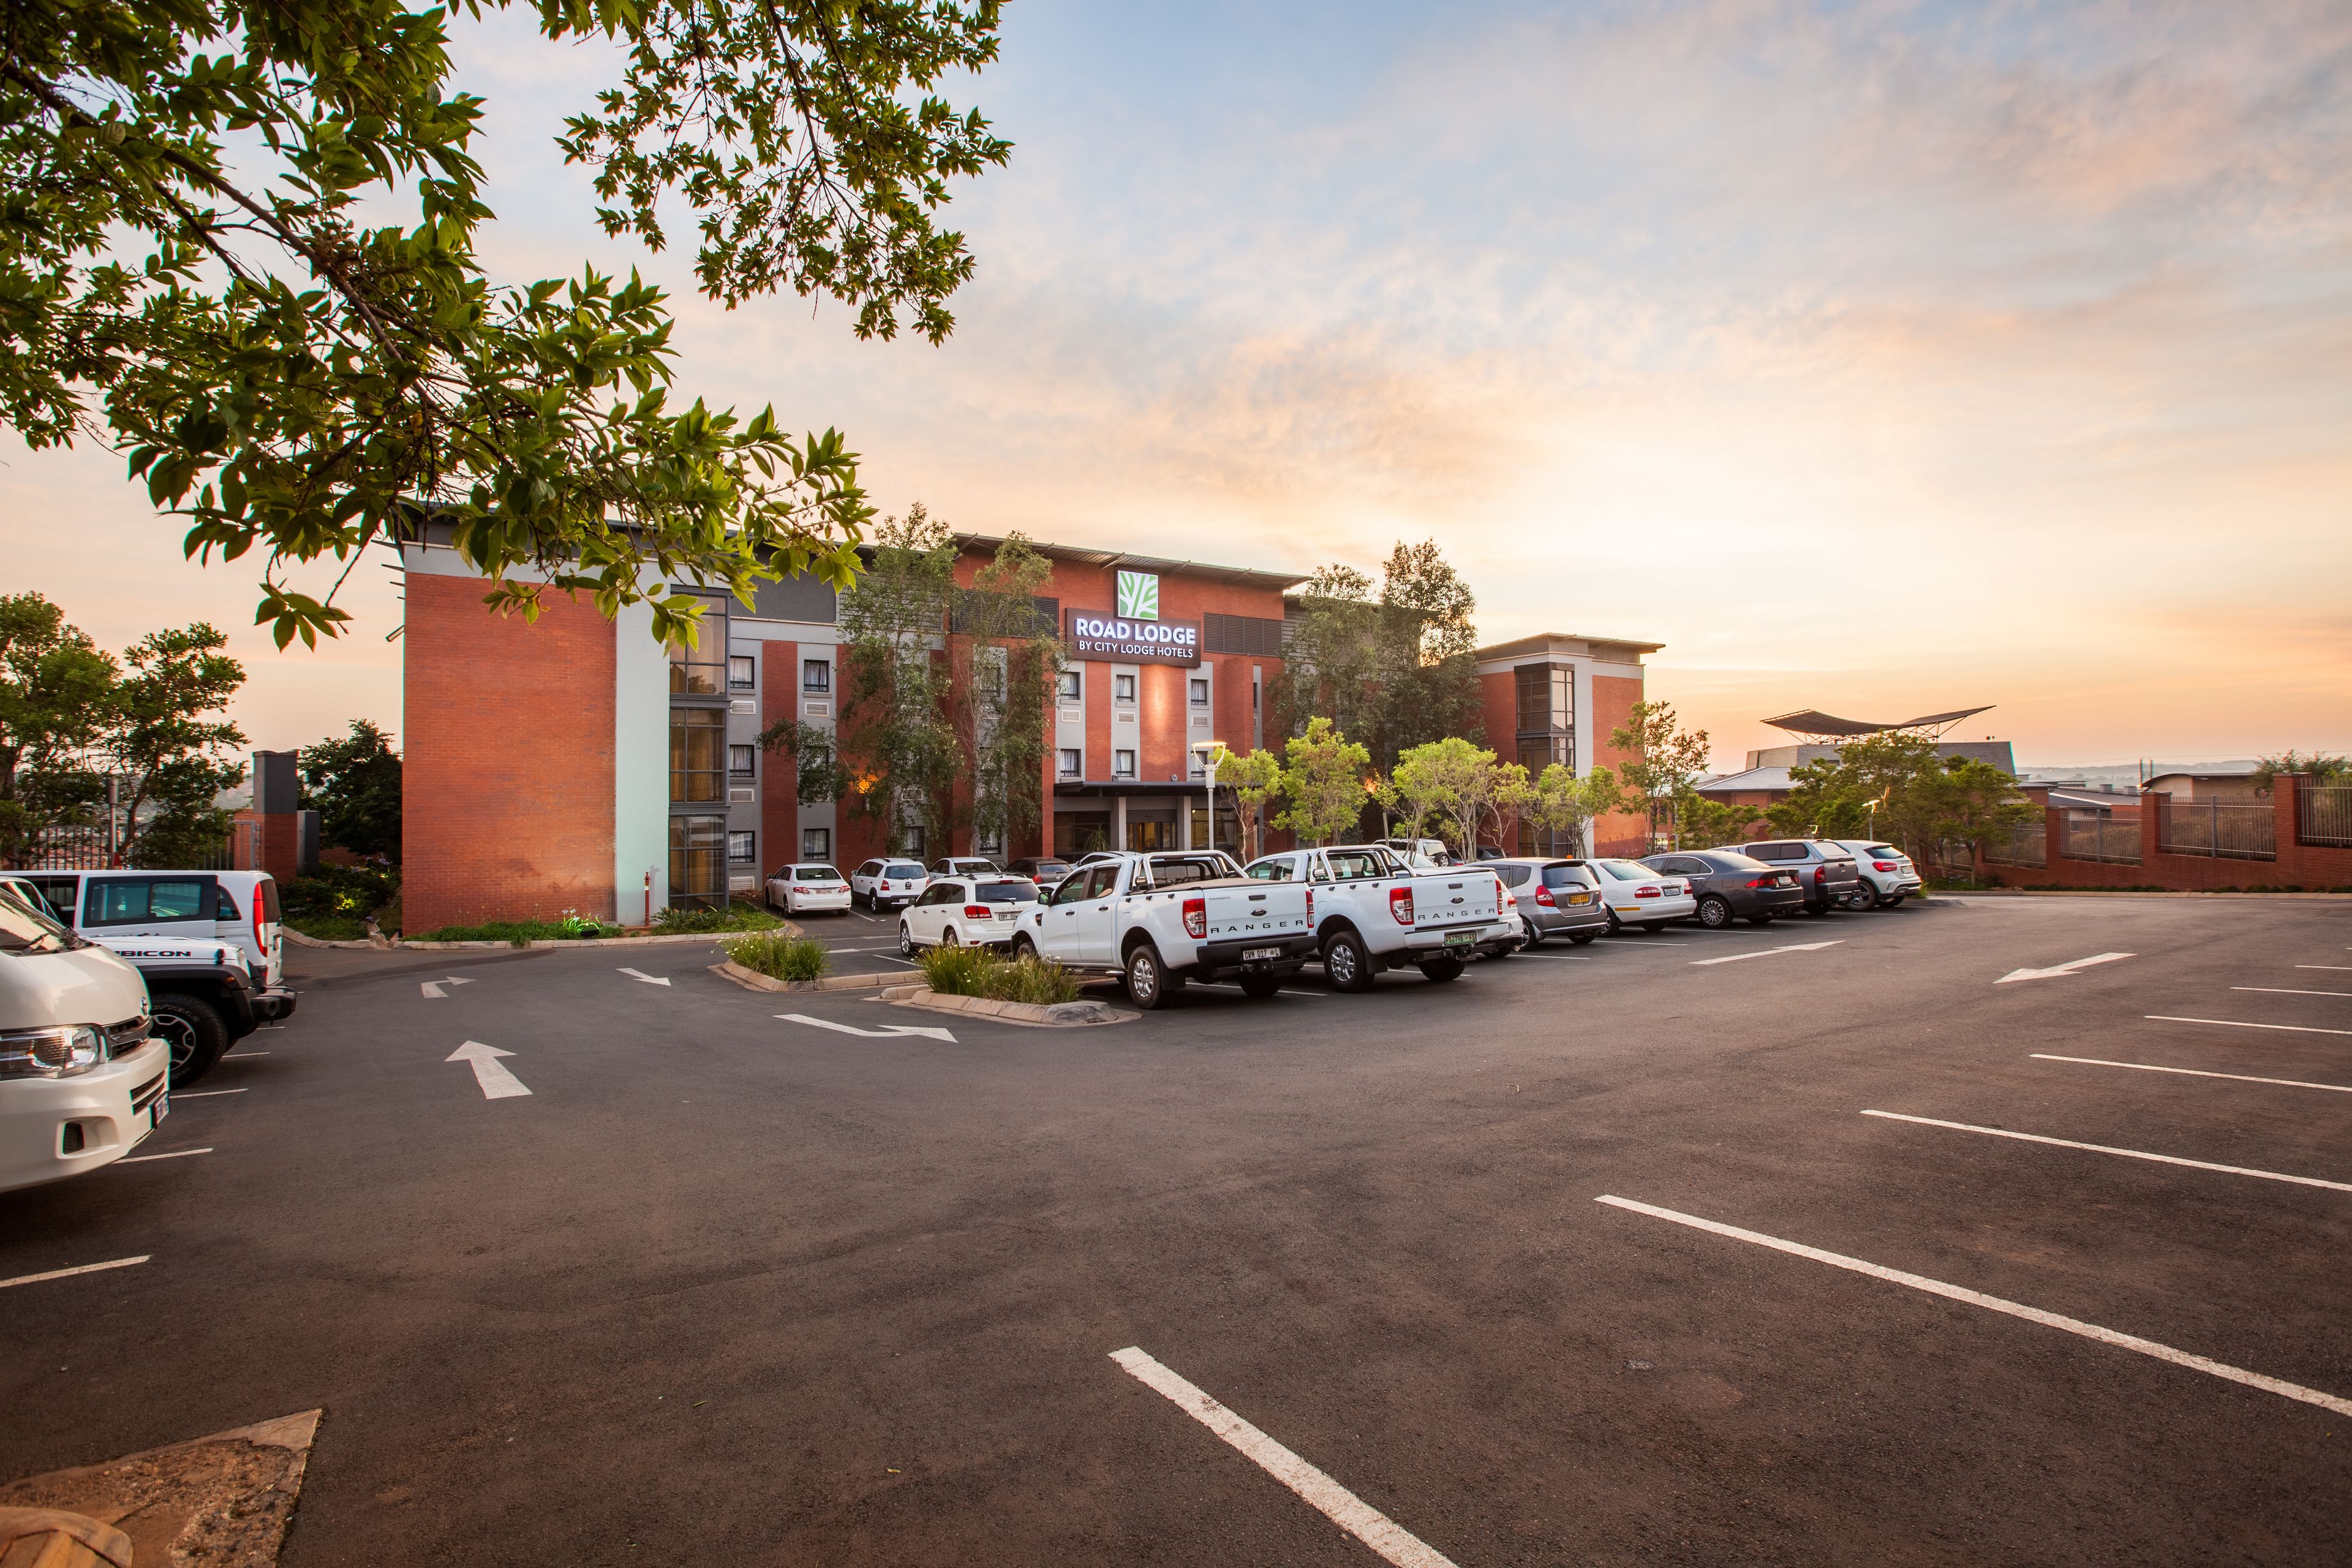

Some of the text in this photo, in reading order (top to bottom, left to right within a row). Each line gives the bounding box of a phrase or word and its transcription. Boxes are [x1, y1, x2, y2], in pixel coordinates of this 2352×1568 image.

[1076, 618, 1196, 645] ROAD LODGE
[1079, 641, 1193, 658] BY CITY LODGE HOTELS
[1417, 908, 1495, 921] RANGER
[1210, 920, 1303, 934] RANGER
